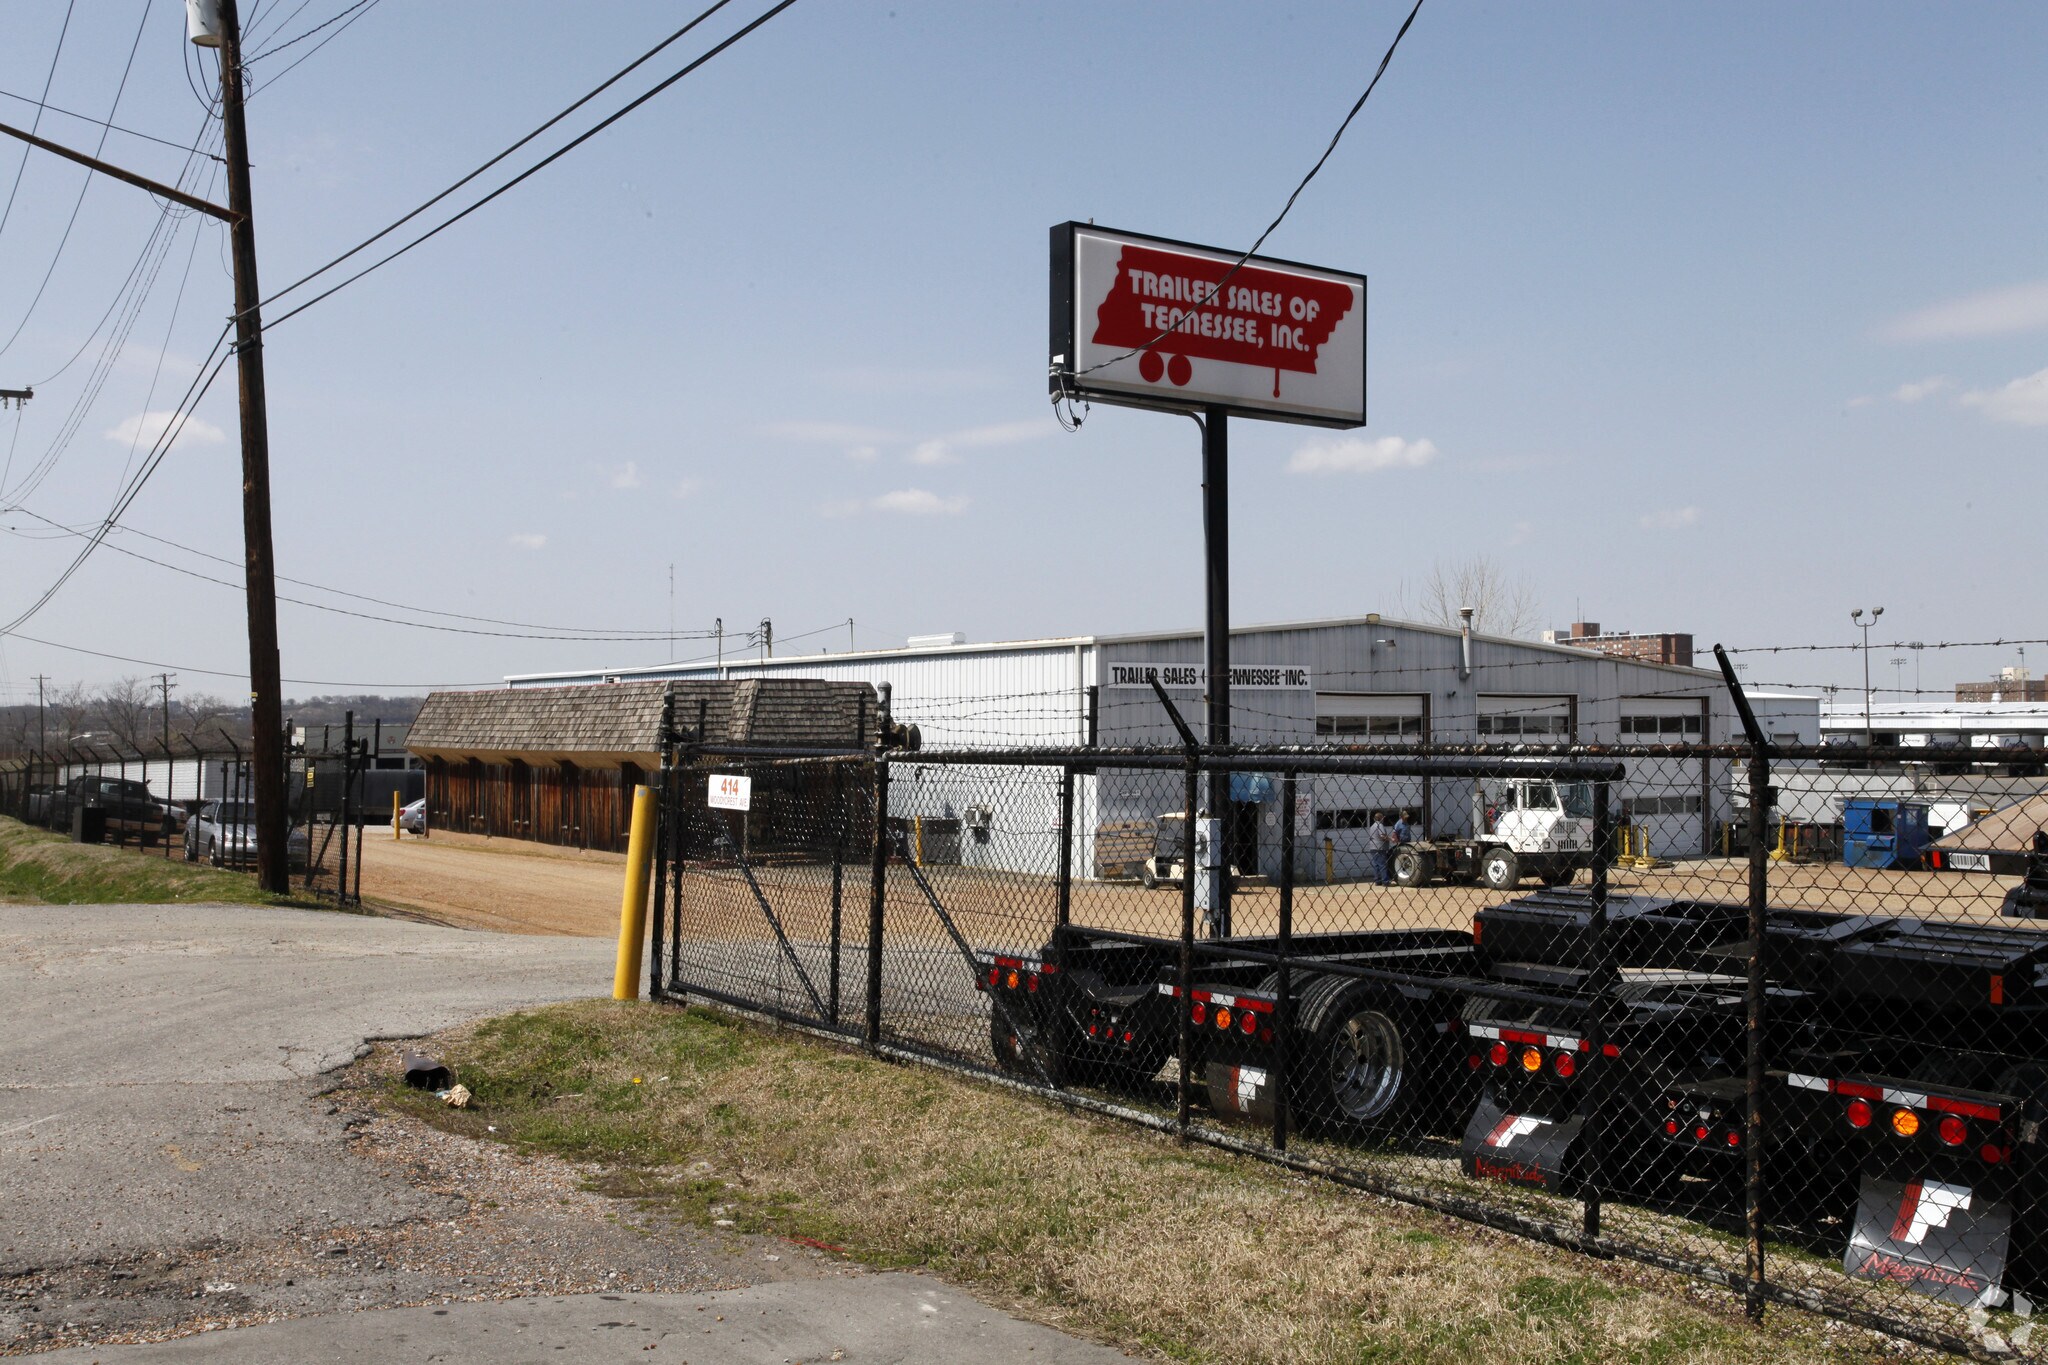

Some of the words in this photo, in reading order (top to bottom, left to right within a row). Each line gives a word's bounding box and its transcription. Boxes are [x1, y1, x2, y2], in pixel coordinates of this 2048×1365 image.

[1128, 269, 1220, 307] TRAILER
[1227, 285, 1282, 318] SALES
[1289, 296, 1320, 322] OF
[1141, 303, 1264, 349] TENNESSEE,
[1271, 323, 1310, 352] INC.
[1163, 667, 1197, 685] SALES
[1229, 668, 1280, 686] ENNESSEE
[1284, 669, 1308, 686] INC.
[721, 778, 738, 796] 414
